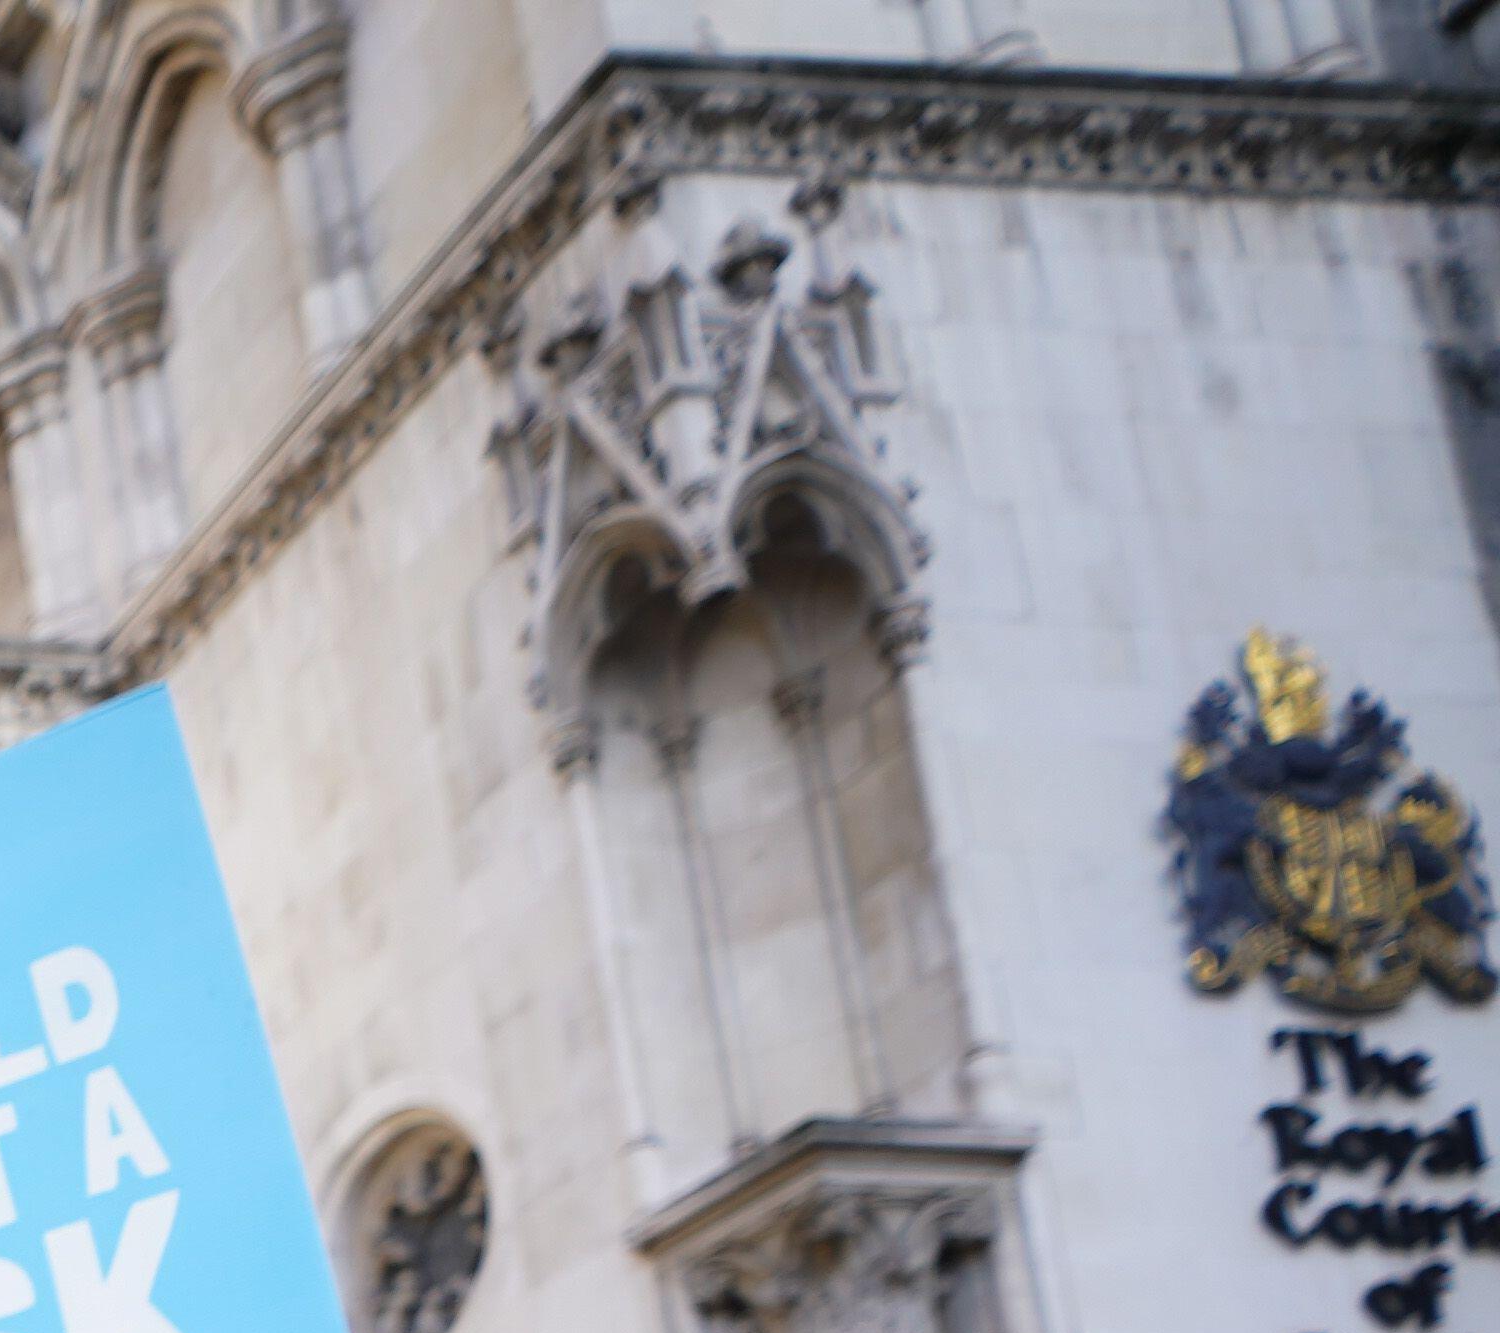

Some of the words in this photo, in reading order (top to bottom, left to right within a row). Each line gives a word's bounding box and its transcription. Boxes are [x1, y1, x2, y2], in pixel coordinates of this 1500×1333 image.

[1270, 1027, 1433, 1098] The
[85, 1066, 170, 1196] A
[1259, 1102, 1488, 1185] Royal
[1262, 1181, 1500, 1250] Court
[1363, 1262, 1453, 1330] of
